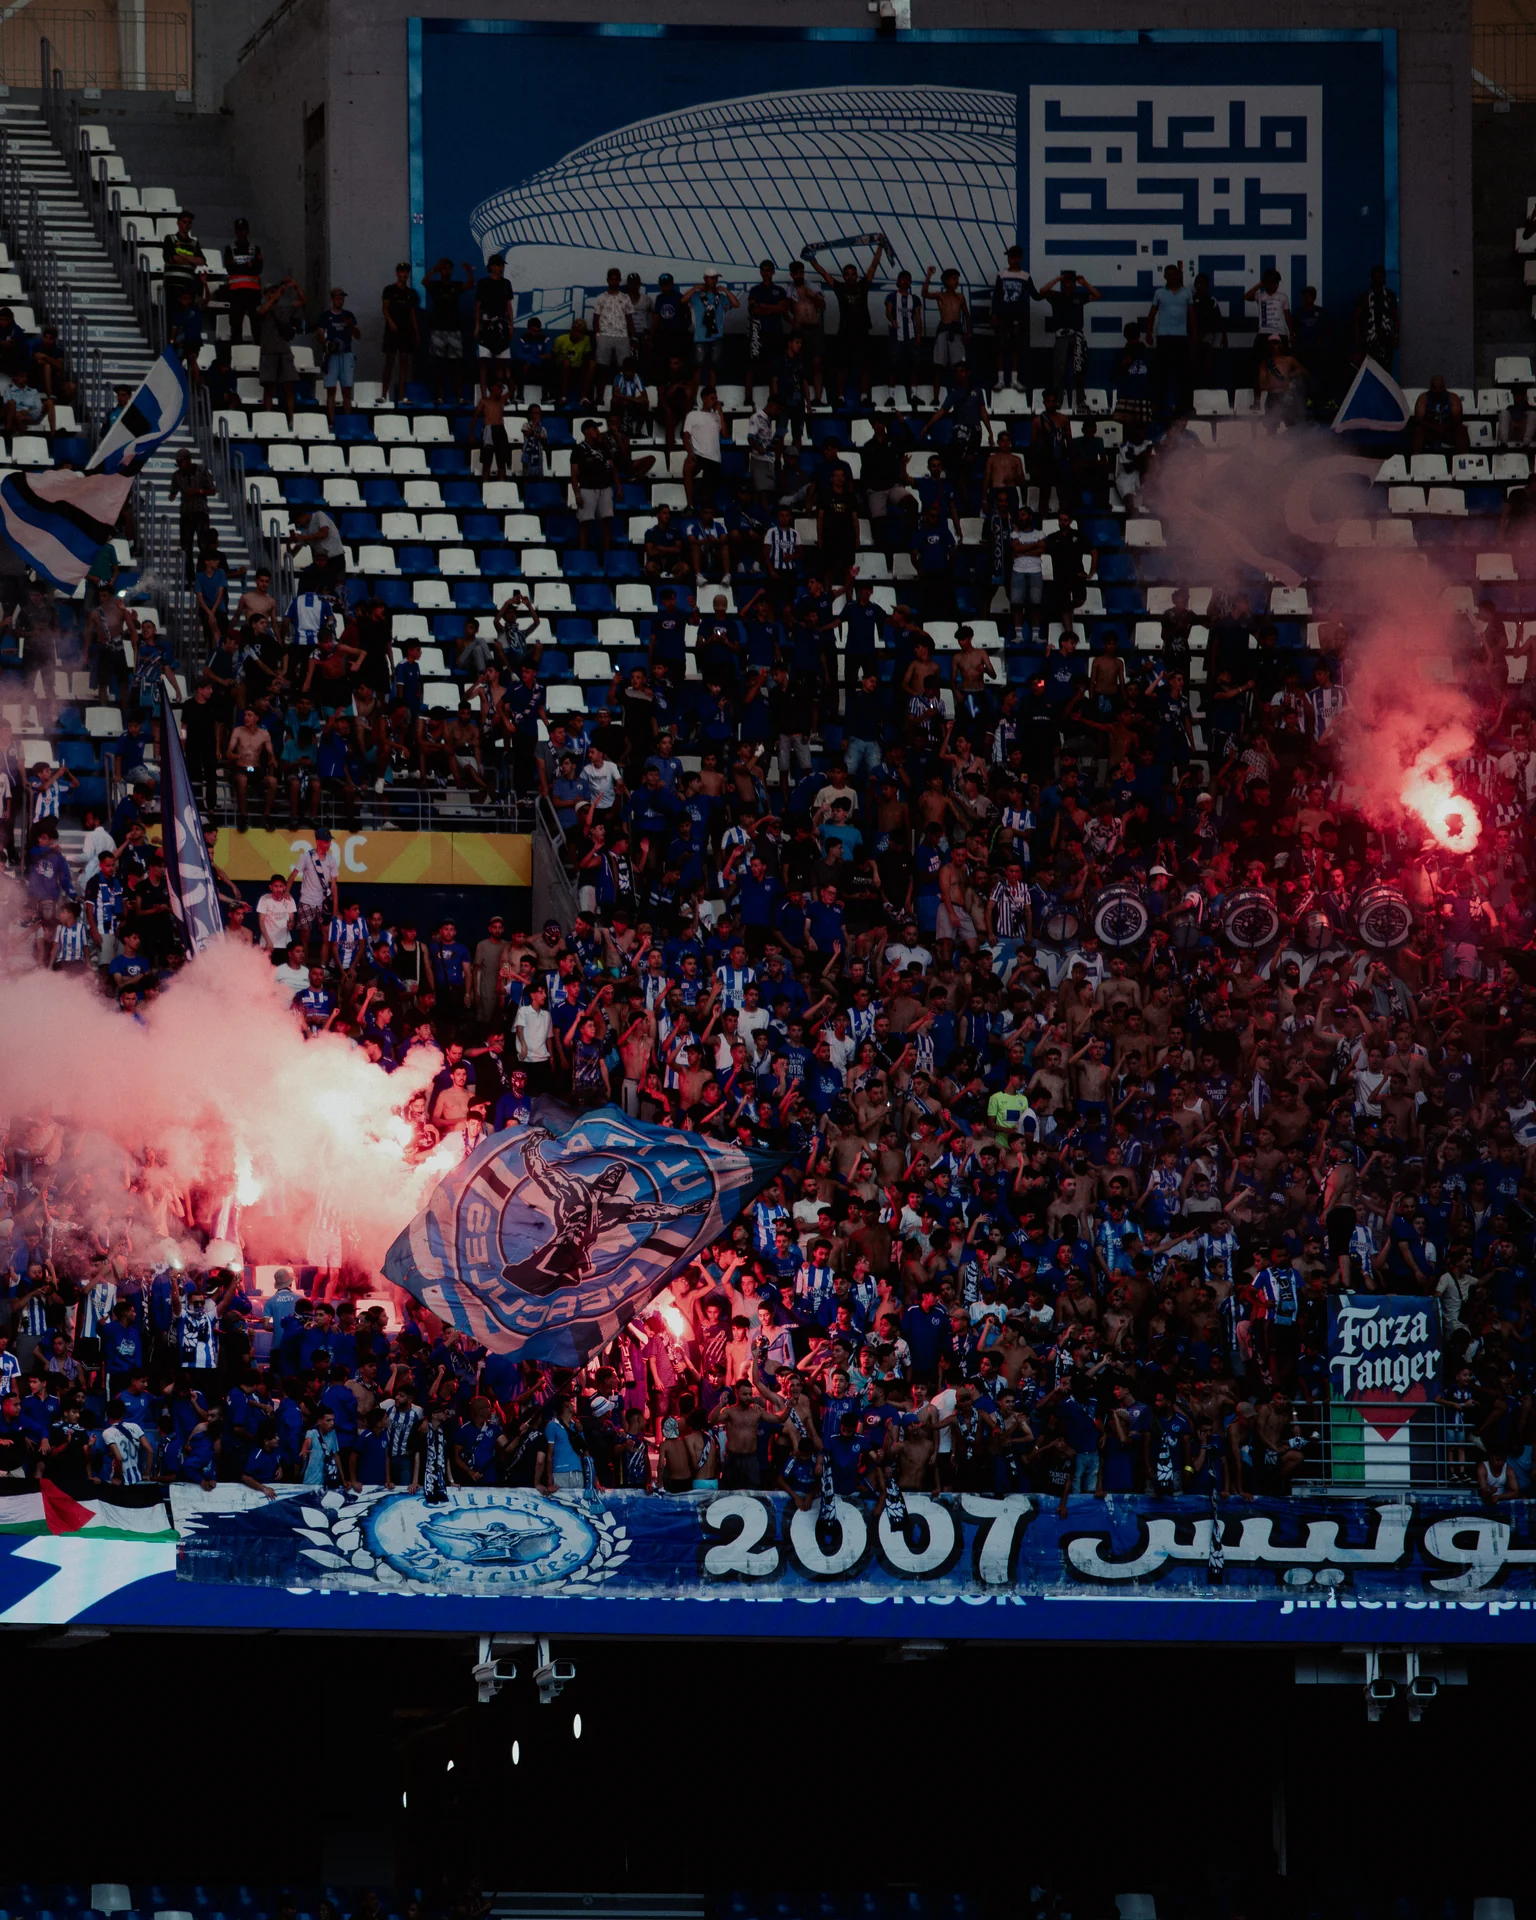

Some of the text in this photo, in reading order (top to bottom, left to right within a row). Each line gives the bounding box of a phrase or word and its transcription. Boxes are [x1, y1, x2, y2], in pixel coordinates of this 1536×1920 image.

[1336, 1304, 1429, 1354] Forza
[1329, 1349, 1442, 1397] Tanger
[1048, 1470, 1068, 1479] TANGE
[704, 1494, 1033, 1584] 2007
[1066, 1504, 1536, 1592] وليس
